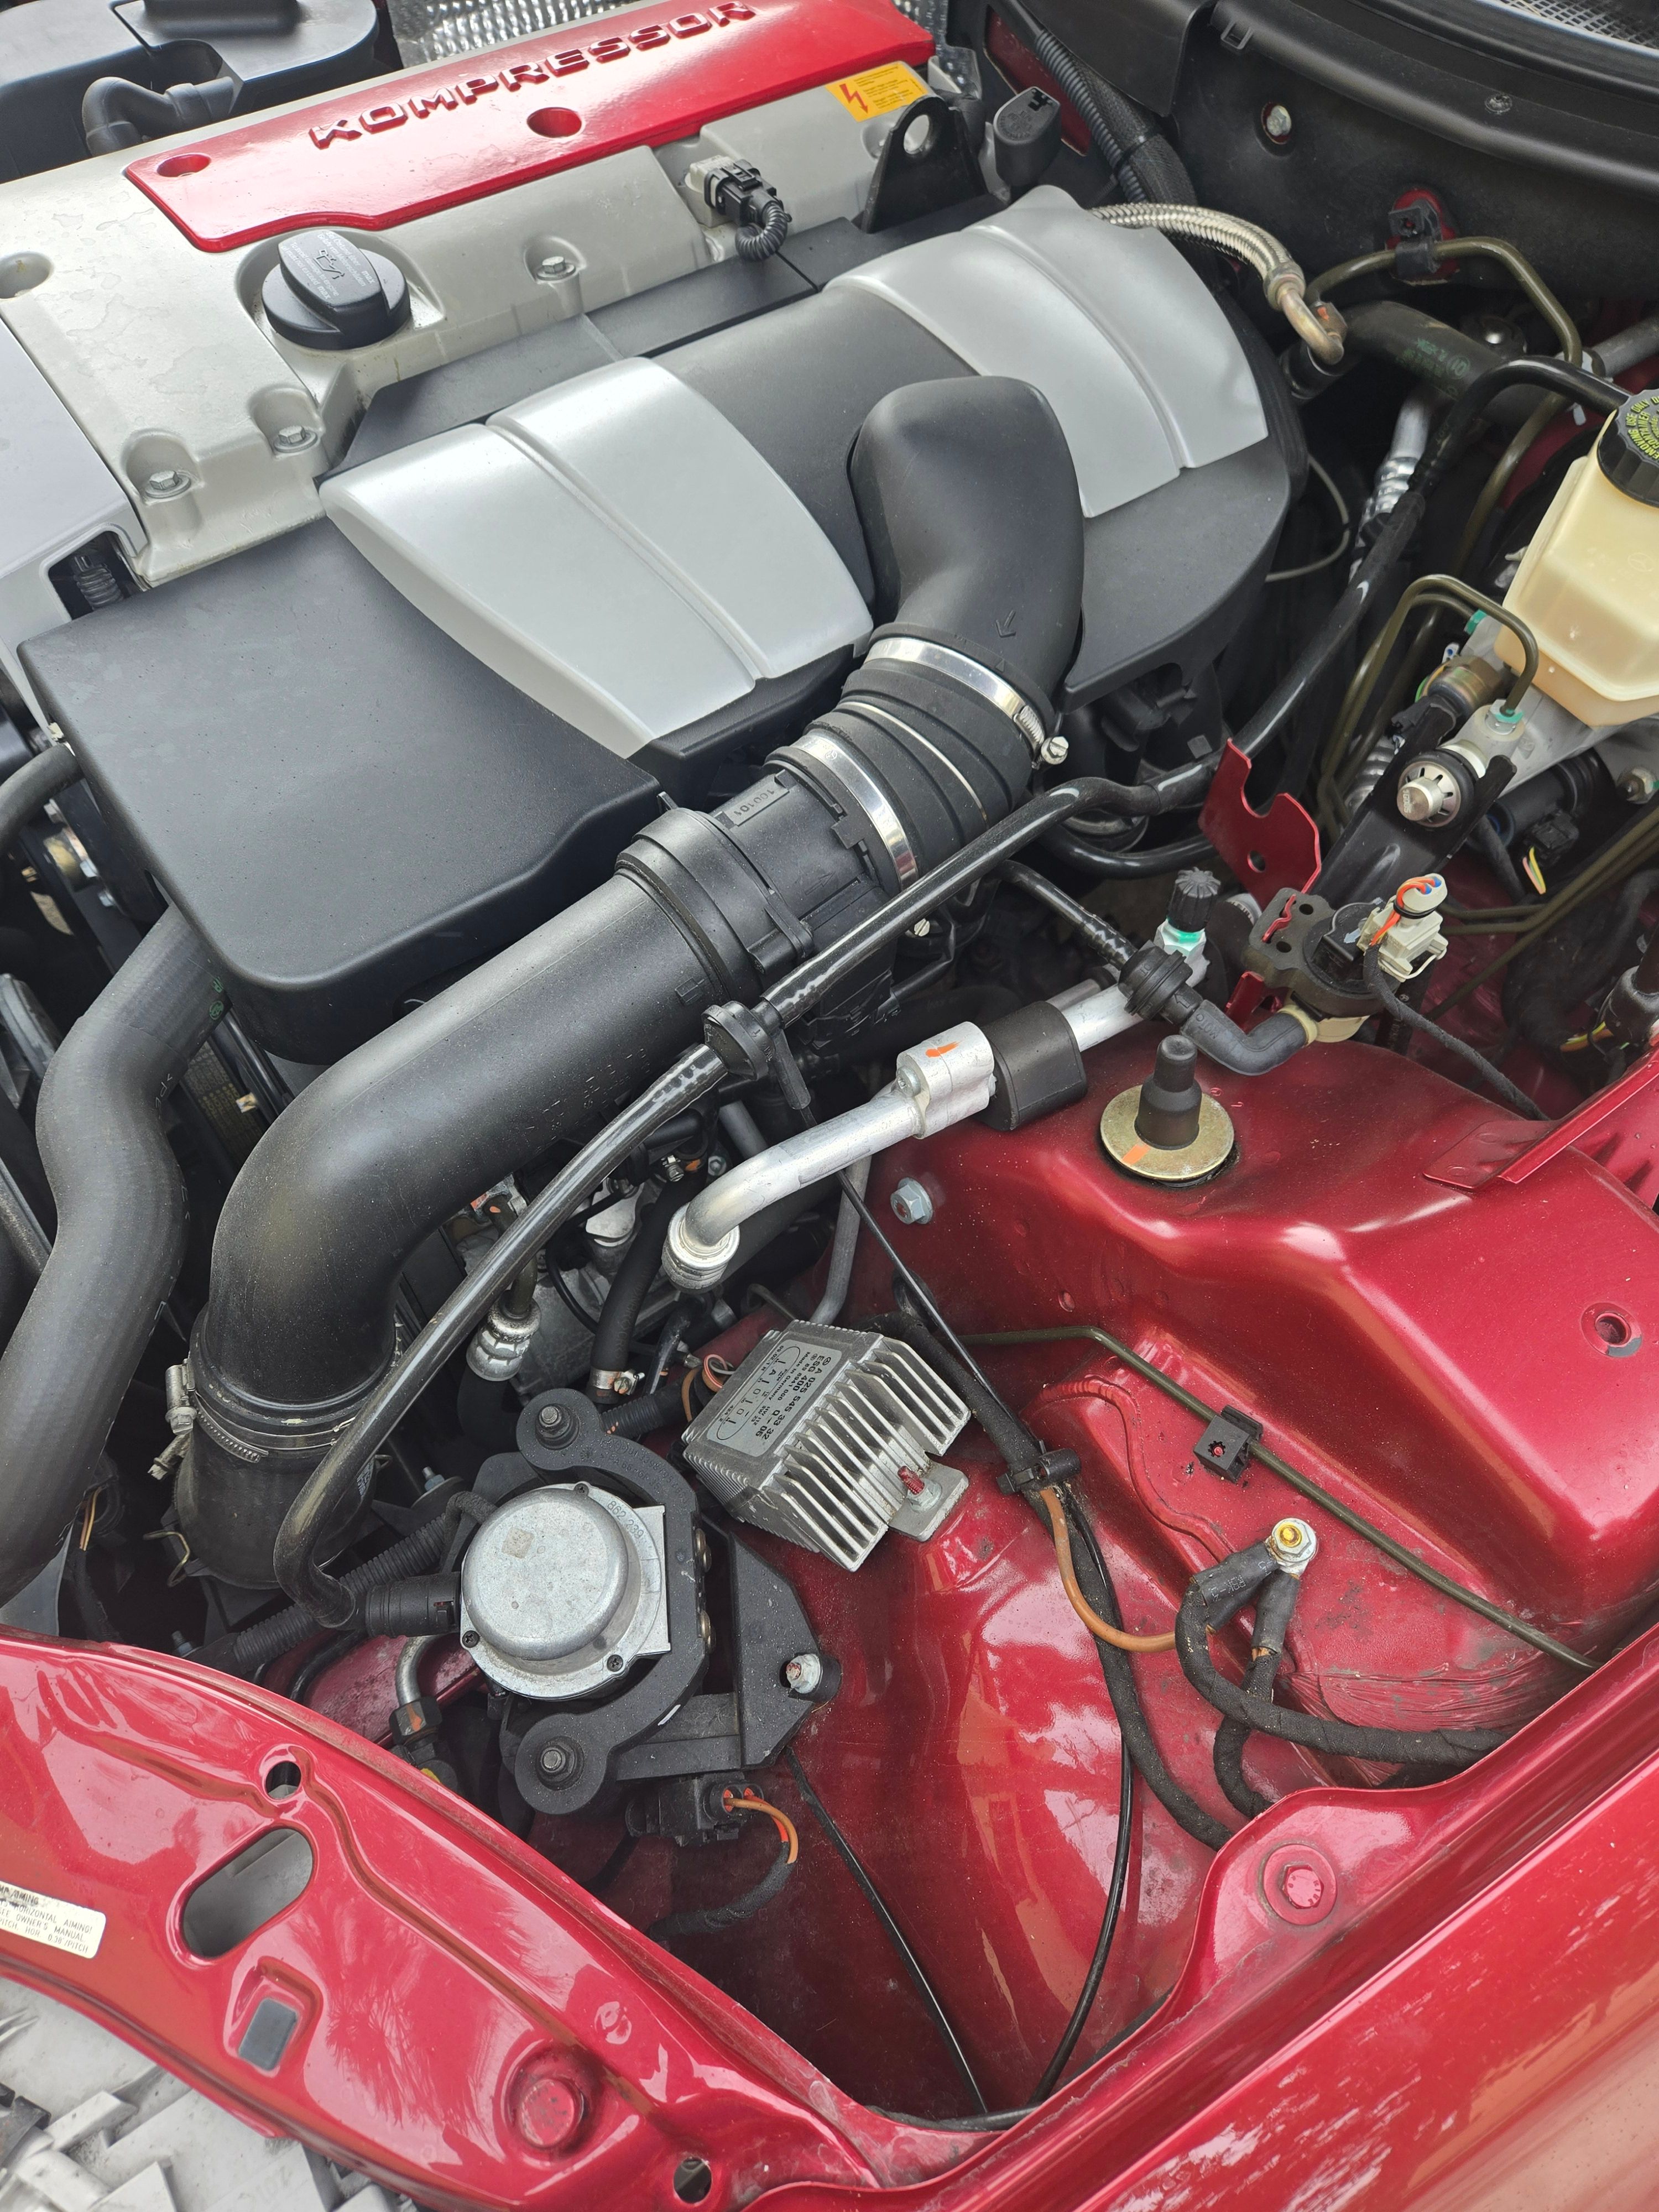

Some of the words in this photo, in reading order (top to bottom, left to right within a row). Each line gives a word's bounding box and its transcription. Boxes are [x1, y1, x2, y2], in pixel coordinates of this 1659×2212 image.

[307, 1, 757, 150] KOMPRESSOR
[300, 267, 320, 287] exceed
[317, 285, 331, 300] max
[361, 269, 375, 284] max
[322, 279, 340, 298] engine
[1631, 399, 1650, 414] ONLY
[1625, 413, 1637, 427] USE
[1628, 429, 1659, 461] EMOVING
[796, 1350, 810, 1367] Made
[807, 1354, 825, 1373] ESG
[768, 1375, 790, 1401] Germany
[792, 1374, 807, 1391] 400
[799, 1376, 815, 1394] 025
[784, 1395, 800, 1412] 545
[773, 1413, 785, 1427] 33
[761, 1427, 774, 1441] 32
[606, 1499, 627, 1521] 862
[16, 1914, 48, 1931] OWNER'S
[64, 1919, 92, 1934] AIMING!
